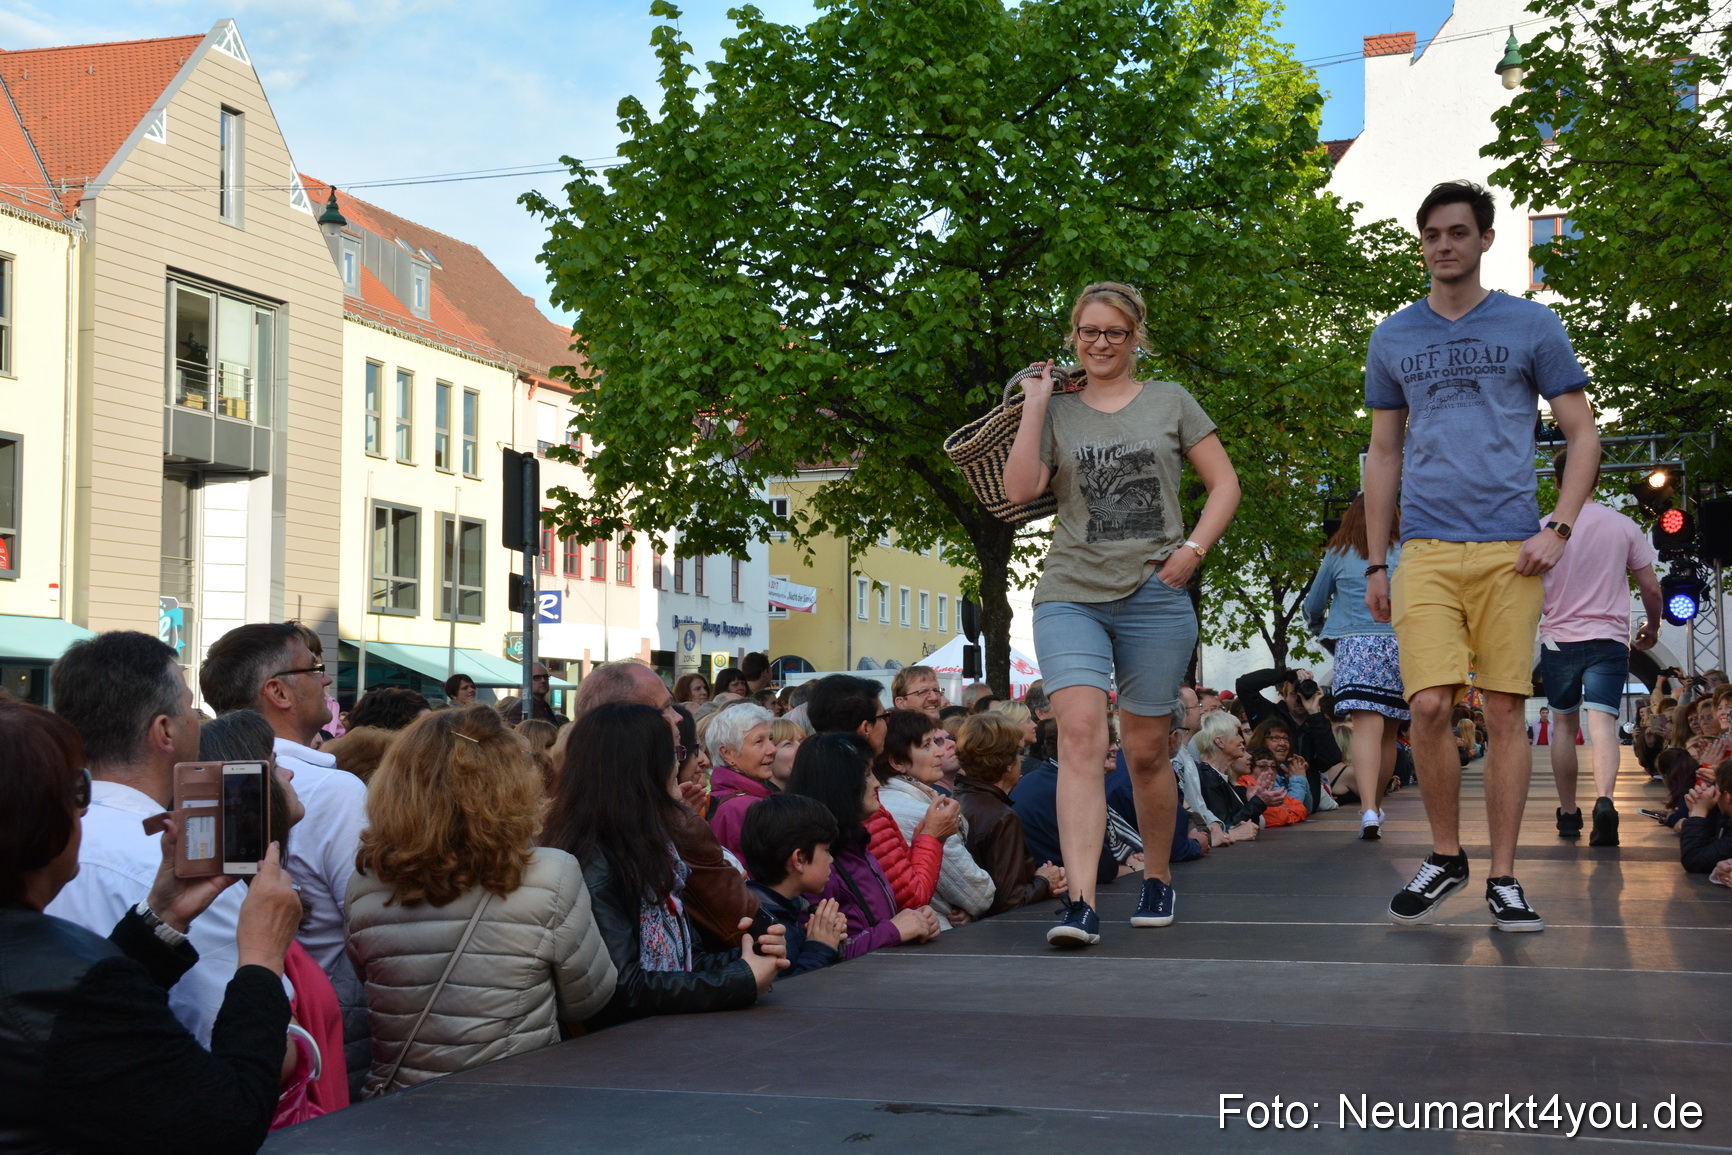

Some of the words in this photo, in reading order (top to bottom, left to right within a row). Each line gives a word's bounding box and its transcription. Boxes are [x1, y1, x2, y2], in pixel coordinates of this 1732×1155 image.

[1401, 351, 1440, 373] OFF
[1448, 344, 1509, 366] ROAD
[1404, 370, 1439, 384] GREAT
[1442, 366, 1506, 377] OUTDOORS
